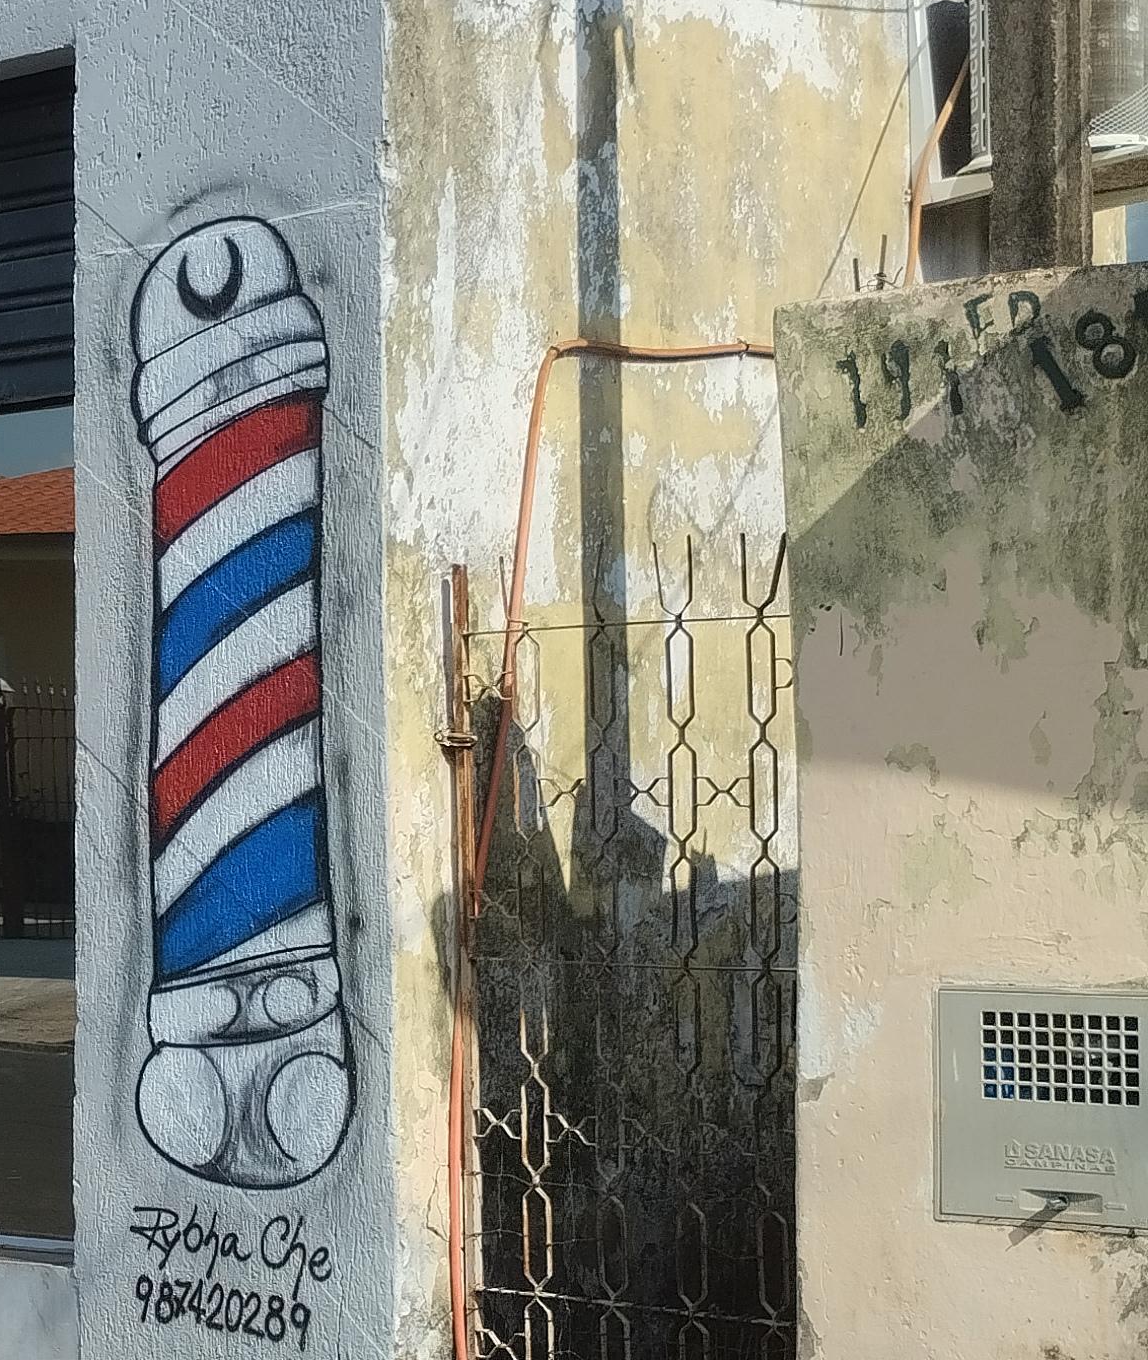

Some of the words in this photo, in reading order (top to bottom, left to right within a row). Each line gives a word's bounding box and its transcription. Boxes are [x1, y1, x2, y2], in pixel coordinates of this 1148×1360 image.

[1003, 1158, 1116, 1173] CAMPINAS
[1024, 1142, 1117, 1165] SANASA
[260, 1214, 334, 1301] Che
[135, 1274, 312, 1352] 987420289
